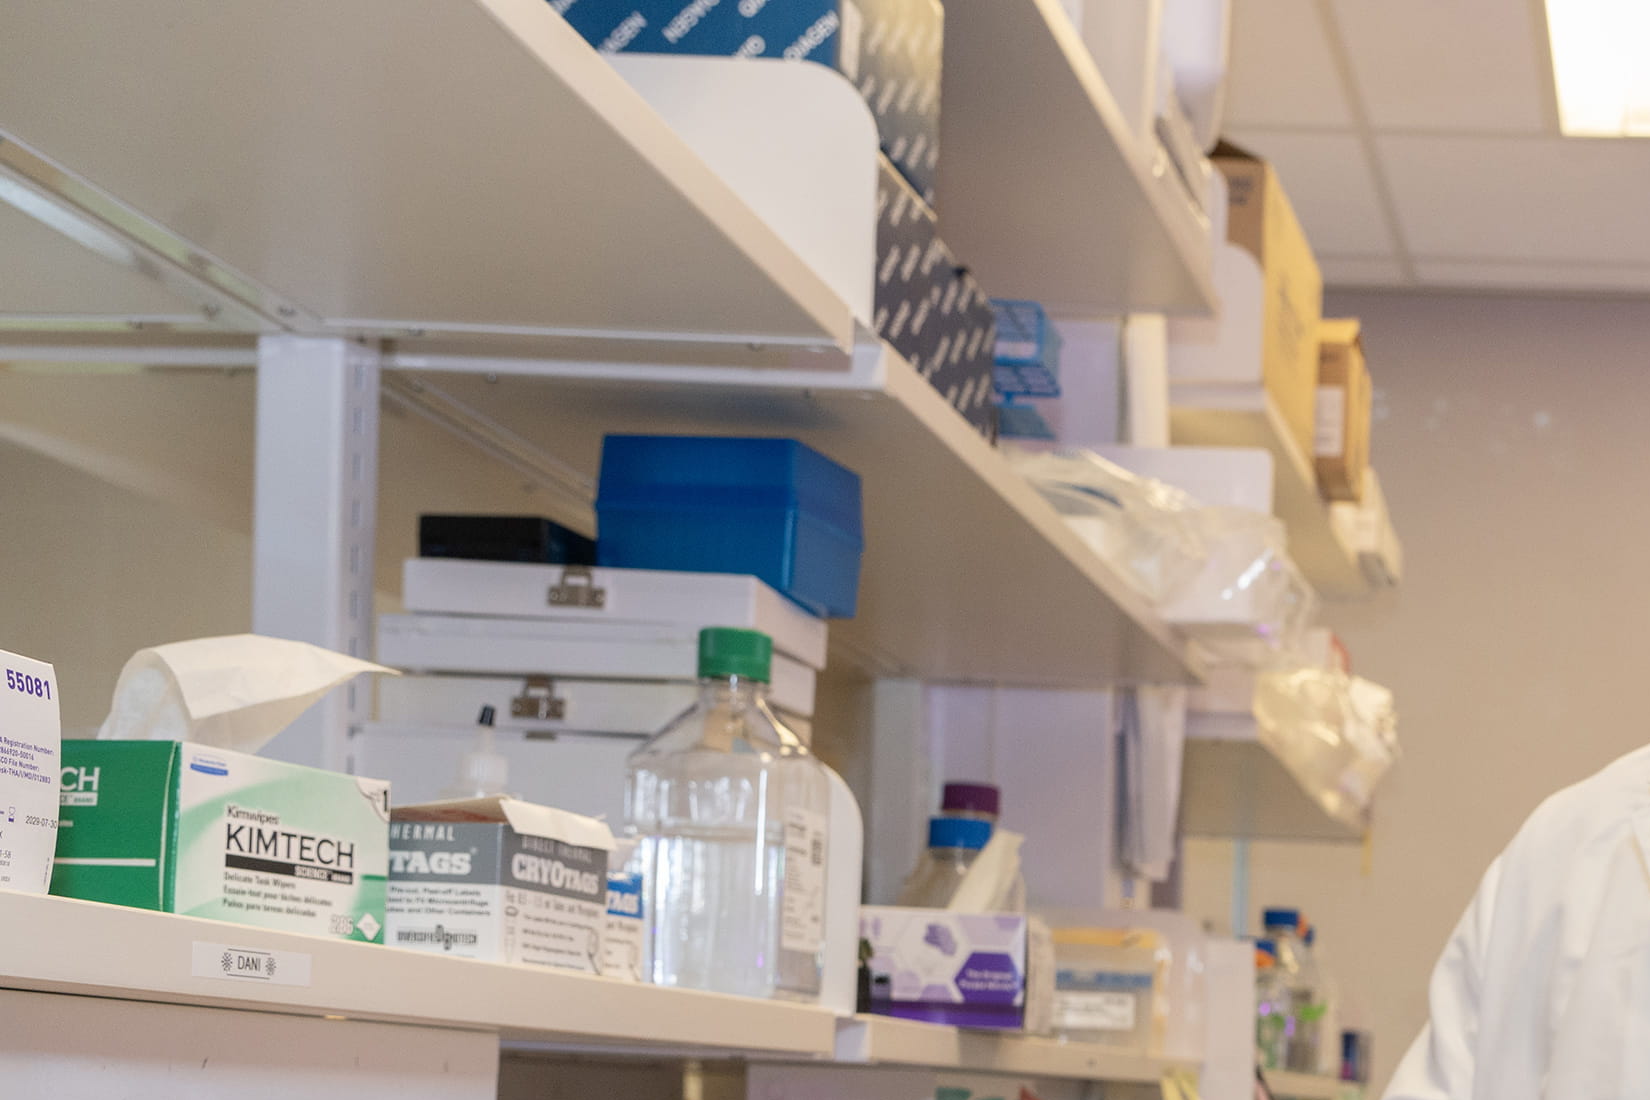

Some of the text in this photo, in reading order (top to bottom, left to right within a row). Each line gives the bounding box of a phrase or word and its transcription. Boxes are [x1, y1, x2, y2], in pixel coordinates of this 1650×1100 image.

[6, 669, 50, 700] 55081
[226, 824, 354, 868] KIMTECH
[389, 850, 472, 876] TAGS
[237, 955, 262, 972] DANI
